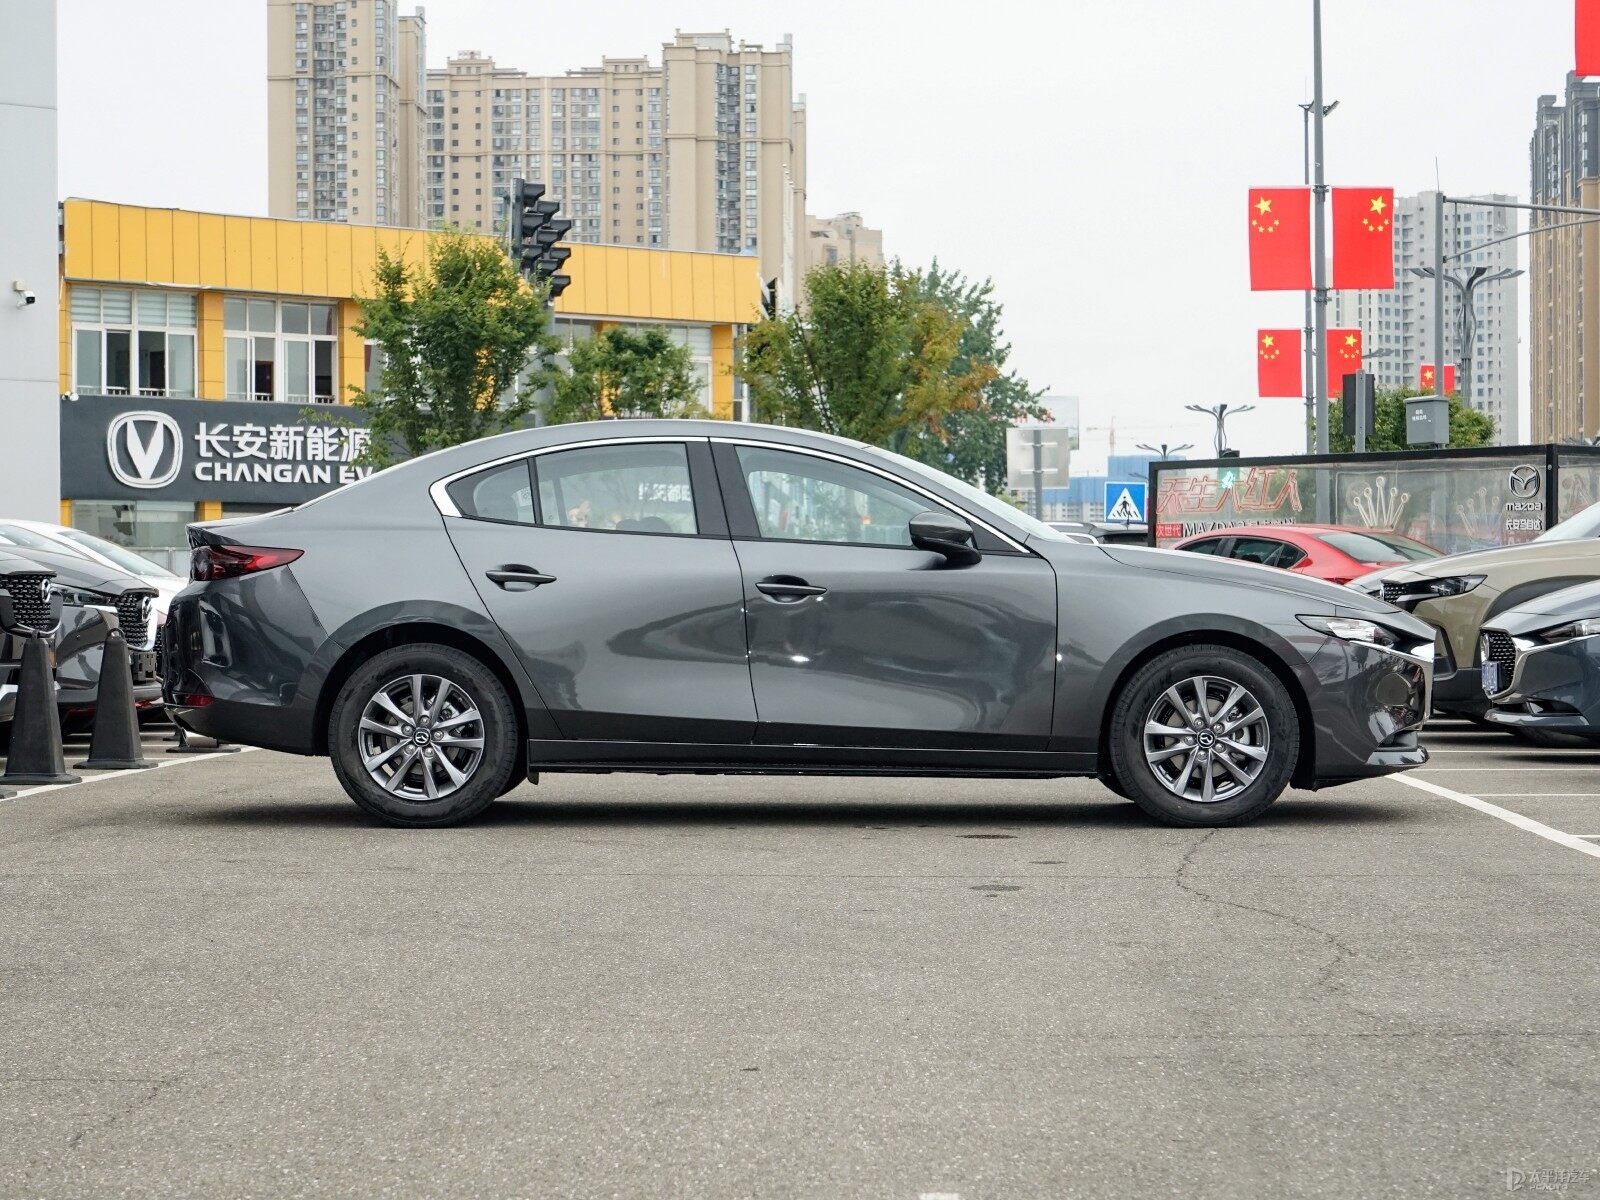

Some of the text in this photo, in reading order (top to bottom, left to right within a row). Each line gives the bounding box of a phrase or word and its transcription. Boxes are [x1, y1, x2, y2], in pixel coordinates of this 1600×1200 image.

[194, 421, 372, 461] 长安新能源
[195, 462, 331, 484] CHANGAN
